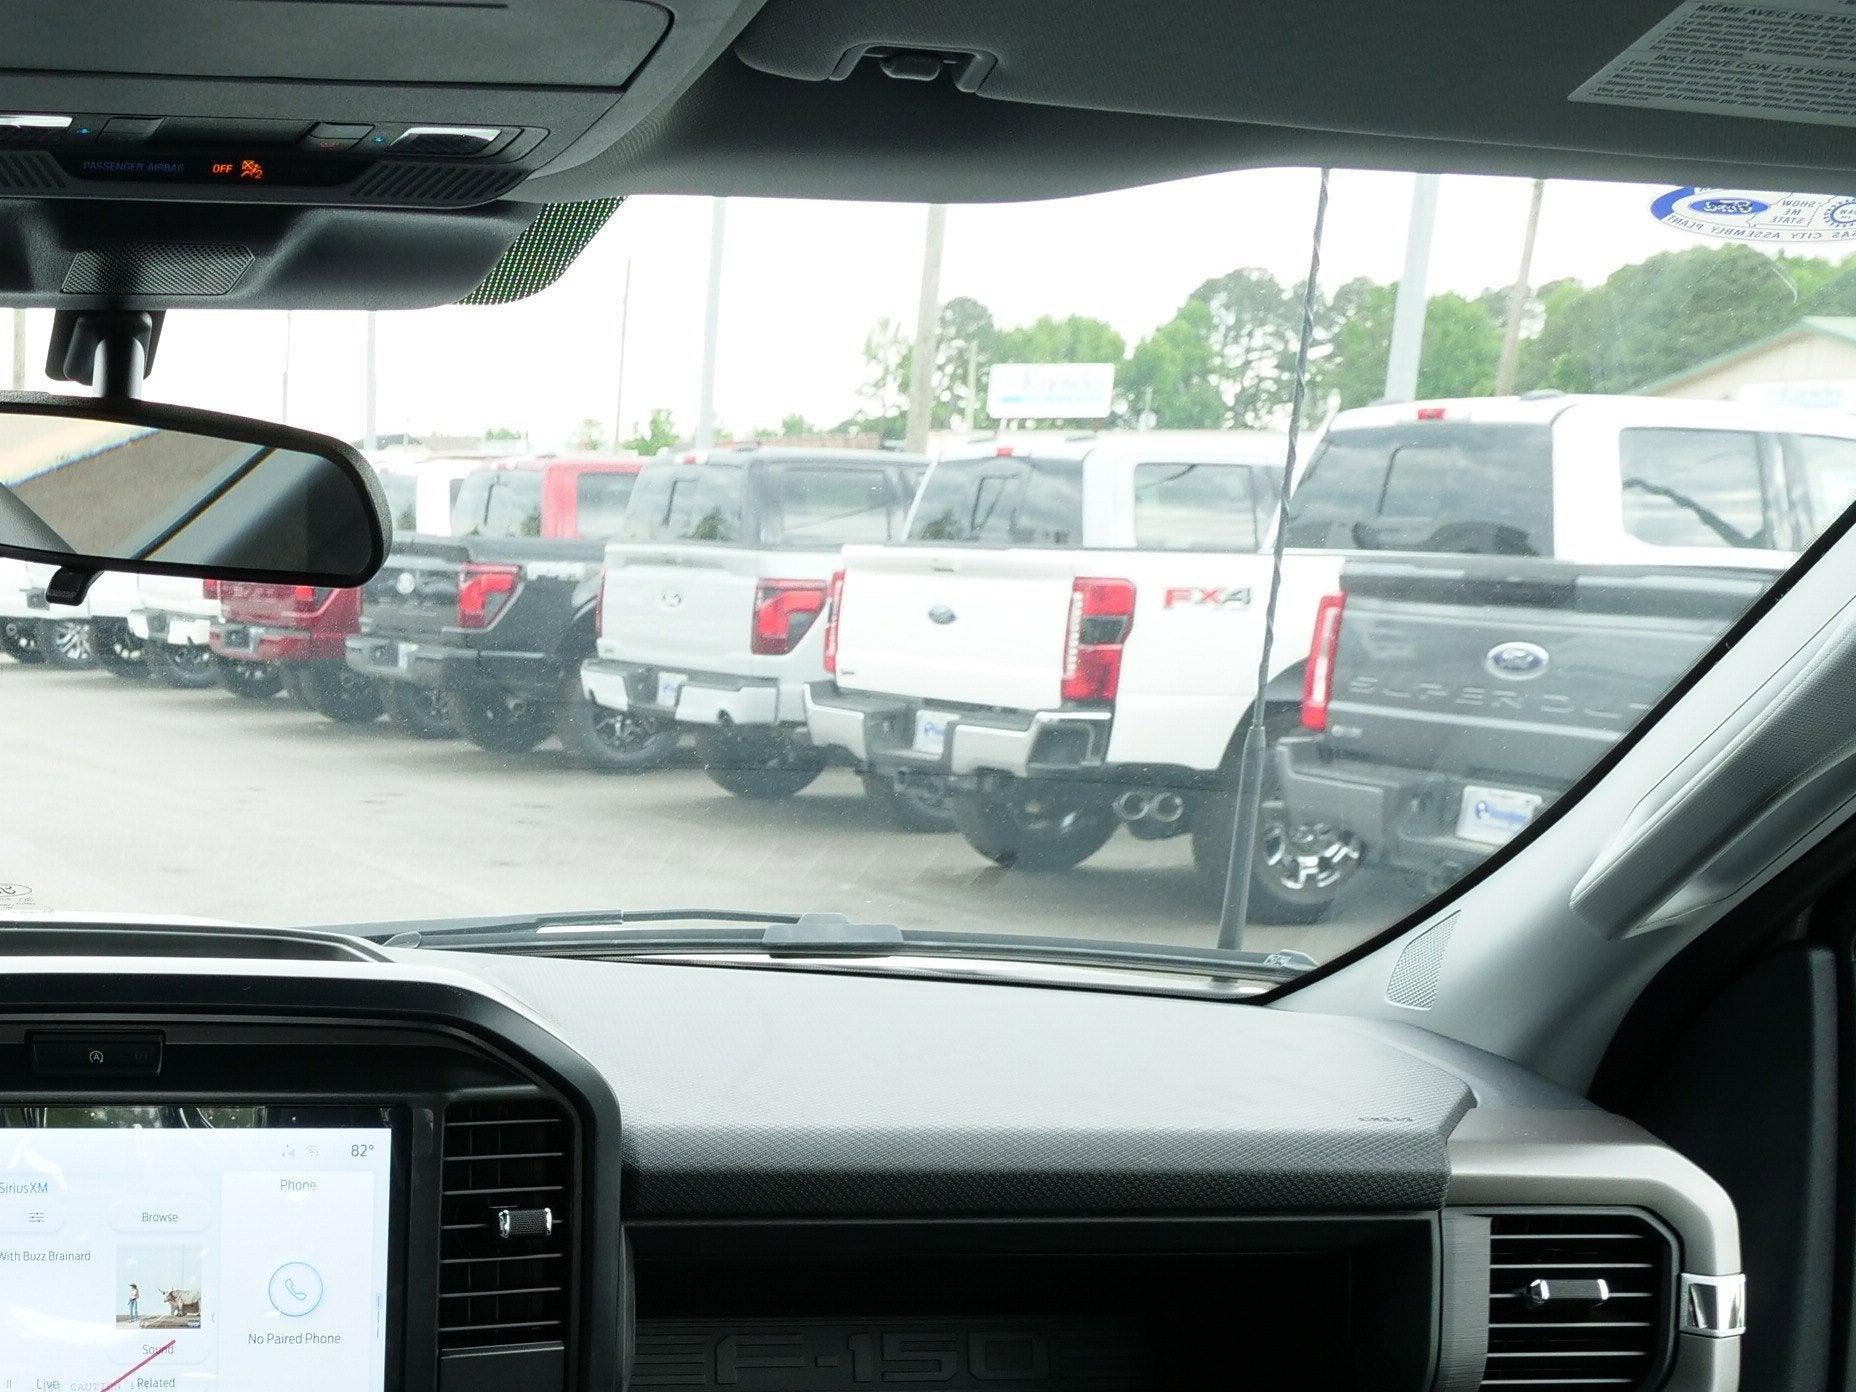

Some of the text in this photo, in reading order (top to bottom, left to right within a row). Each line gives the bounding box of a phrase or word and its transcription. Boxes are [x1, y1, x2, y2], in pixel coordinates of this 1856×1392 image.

[1654, 55, 1733, 67] INCLUSIVE
[1736, 63, 1773, 71] CON
[1775, 65, 1804, 74] LAS
[83, 161, 232, 173] PASSENGER AIRBAG OFF
[1163, 586, 1251, 608] FX4
[350, 1144, 374, 1158] 82°
[280, 1179, 317, 1191] Phone
[142, 1212, 178, 1222] Browse
[23, 1251, 46, 1261] Buzz
[48, 1251, 91, 1261] Brainard
[248, 1333, 341, 1344] No Paired Phone
[142, 1344, 174, 1354] Sound
[715, 1331, 1045, 1385] F-150
[36, 1379, 60, 1390] Live
[137, 1378, 175, 1388] Related
